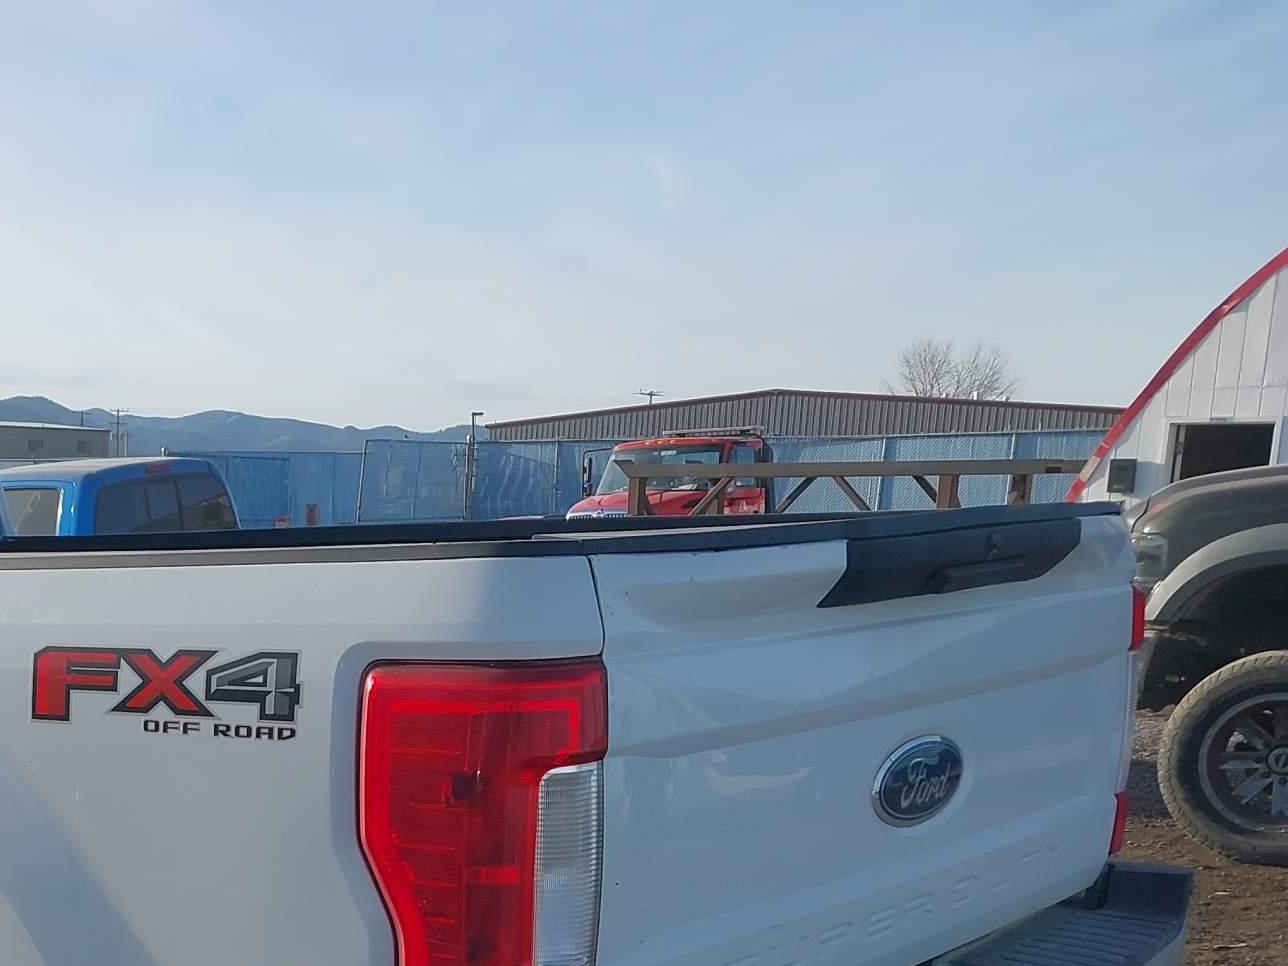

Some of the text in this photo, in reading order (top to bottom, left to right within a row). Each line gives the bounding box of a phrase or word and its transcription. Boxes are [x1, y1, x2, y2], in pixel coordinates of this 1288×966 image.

[31, 645, 302, 723] FX4
[143, 719, 297, 741] OFF ROAD
